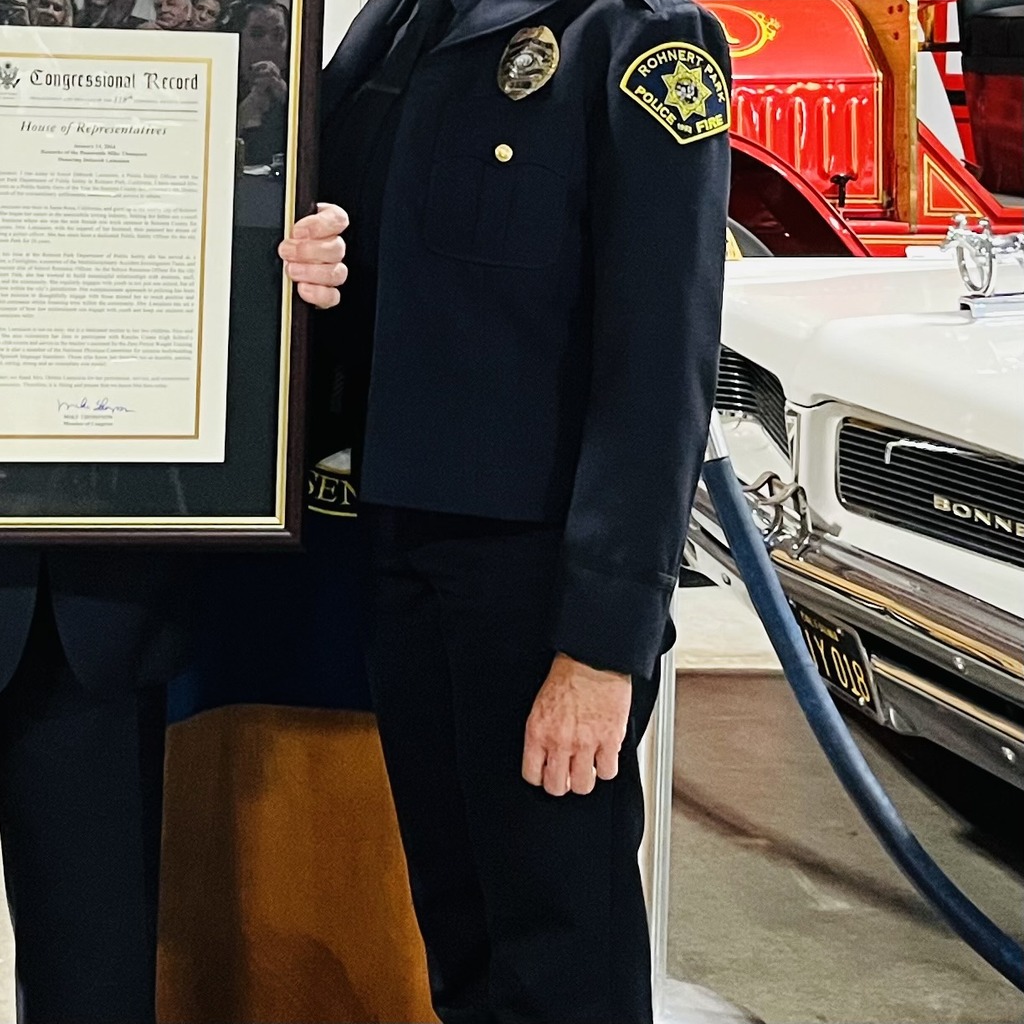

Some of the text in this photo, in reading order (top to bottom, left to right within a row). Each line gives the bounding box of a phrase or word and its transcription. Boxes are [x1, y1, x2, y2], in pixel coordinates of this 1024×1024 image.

[30, 69, 198, 90] Congressional Record
[637, 49, 726, 103] ROHNERT PARK
[634, 85, 724, 134] POLICE FIRE
[20, 121, 167, 136] House of Representatives
